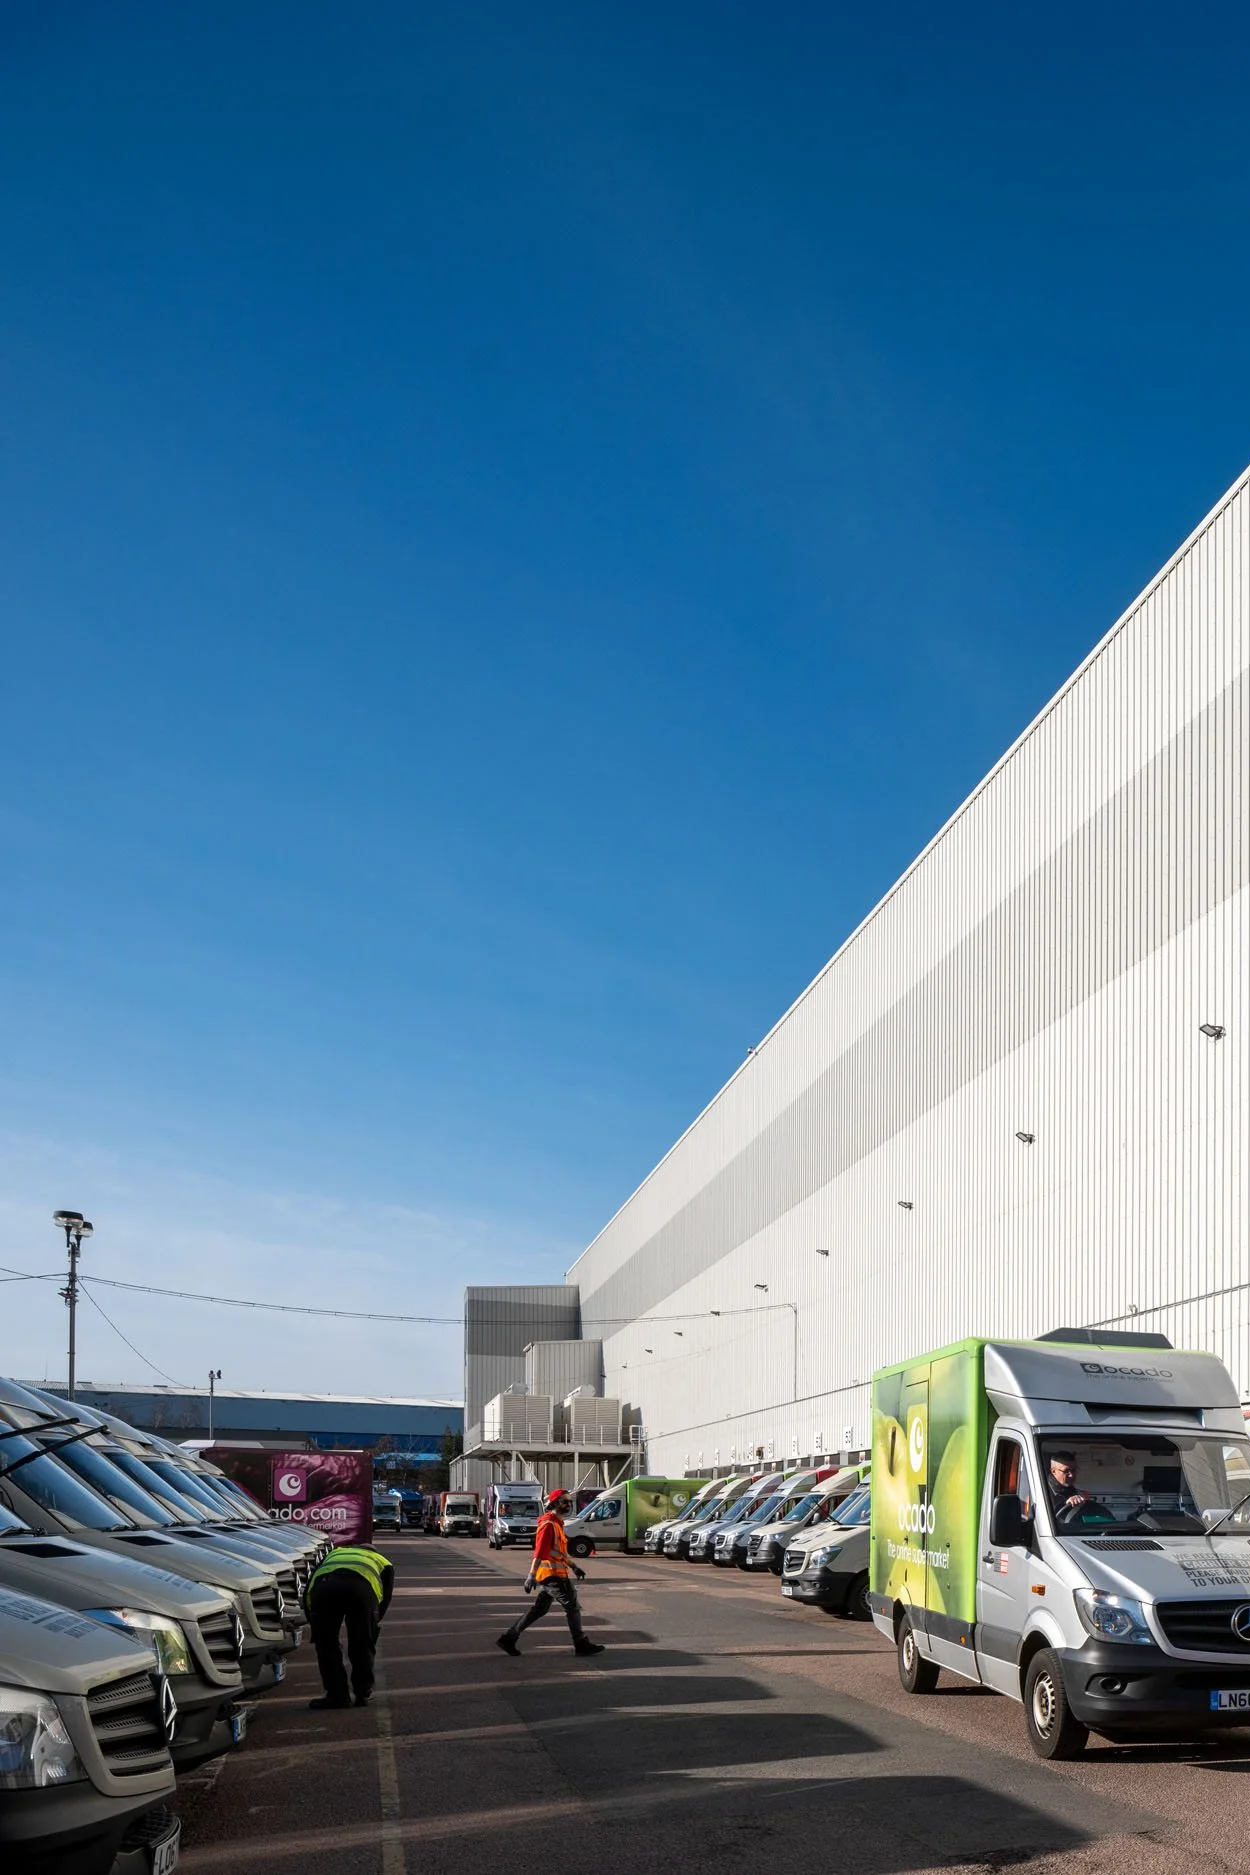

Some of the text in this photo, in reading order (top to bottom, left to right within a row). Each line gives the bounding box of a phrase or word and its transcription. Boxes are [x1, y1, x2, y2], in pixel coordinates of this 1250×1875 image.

[1104, 1366, 1173, 1378] ocado
[267, 1504, 347, 1521] ado.com
[898, 1492, 935, 1534] ocado
[1185, 1569, 1223, 1578] PLEASE
[1190, 1578, 1207, 1588] TO
[1207, 1576, 1240, 1586] YOUR
